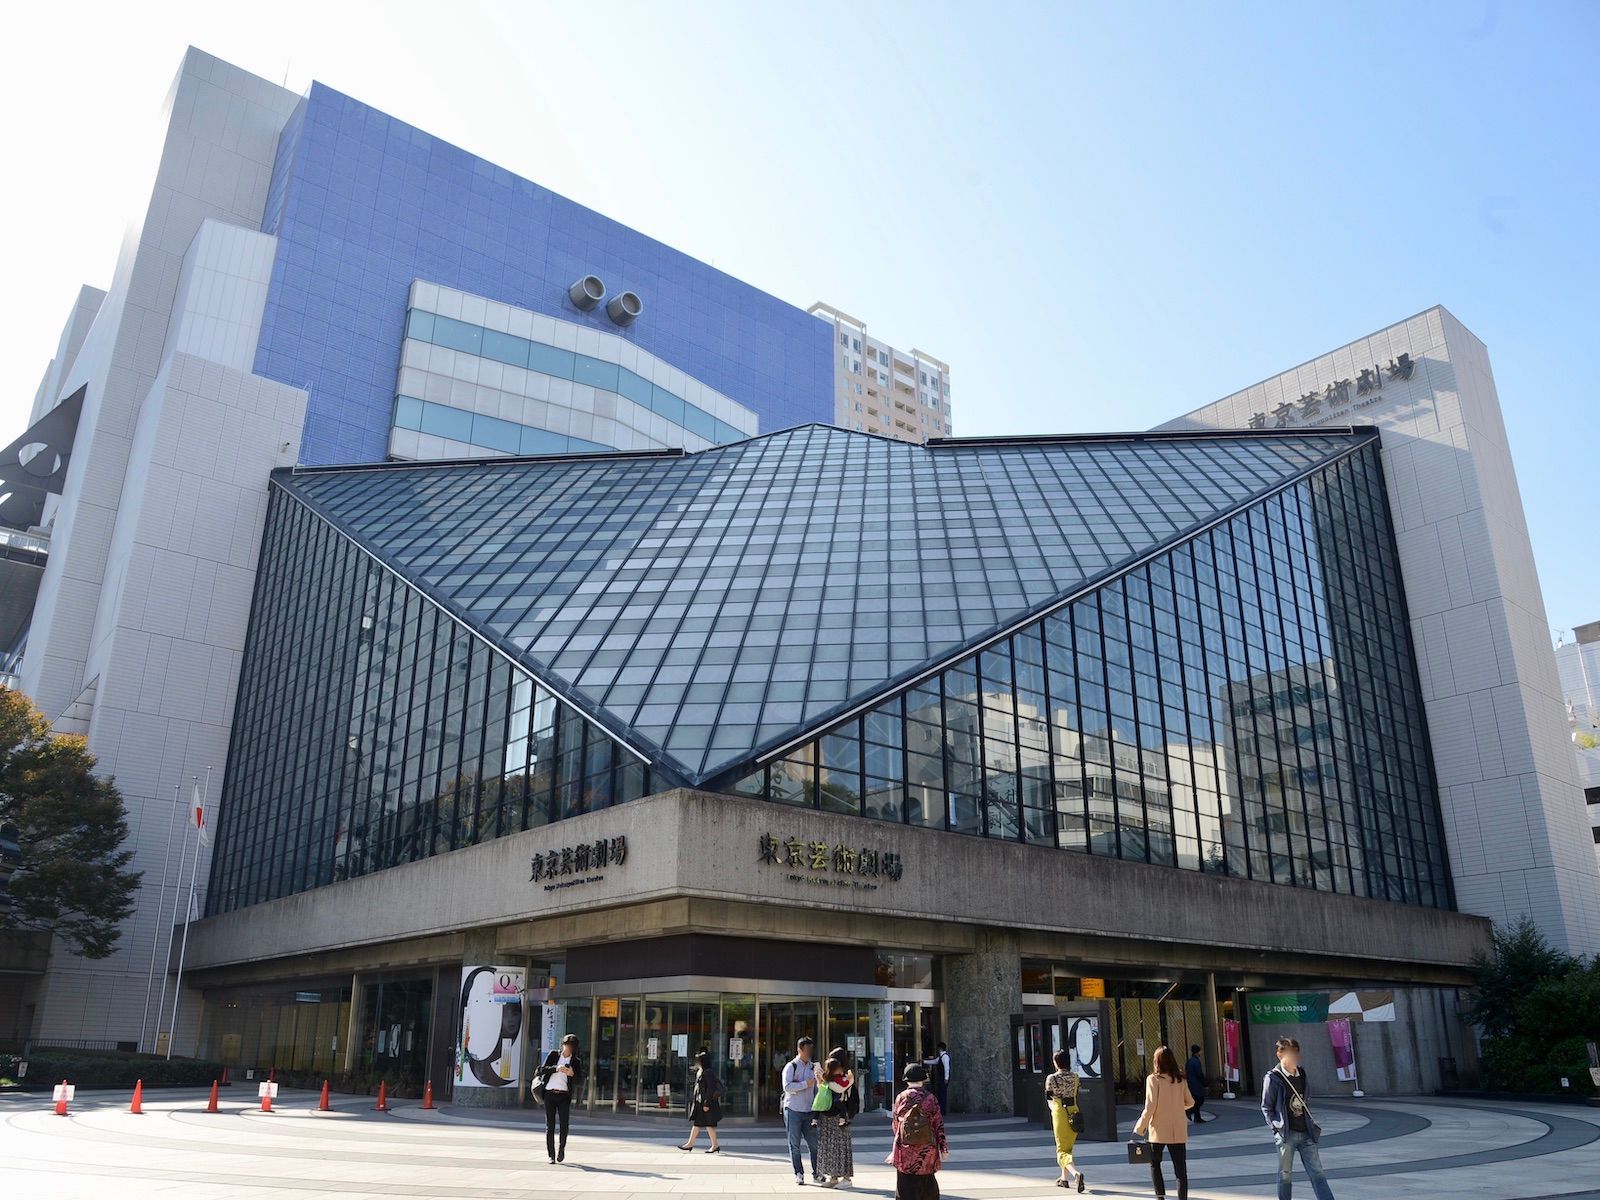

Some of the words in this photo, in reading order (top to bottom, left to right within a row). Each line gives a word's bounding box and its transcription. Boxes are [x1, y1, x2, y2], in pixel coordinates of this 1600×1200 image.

[530, 835, 626, 883] 東京芸術劇場
[759, 832, 903, 882] 東京芸術劇場
[500, 974, 511, 991] Q
[1273, 1005, 1292, 1013] TOKYO
